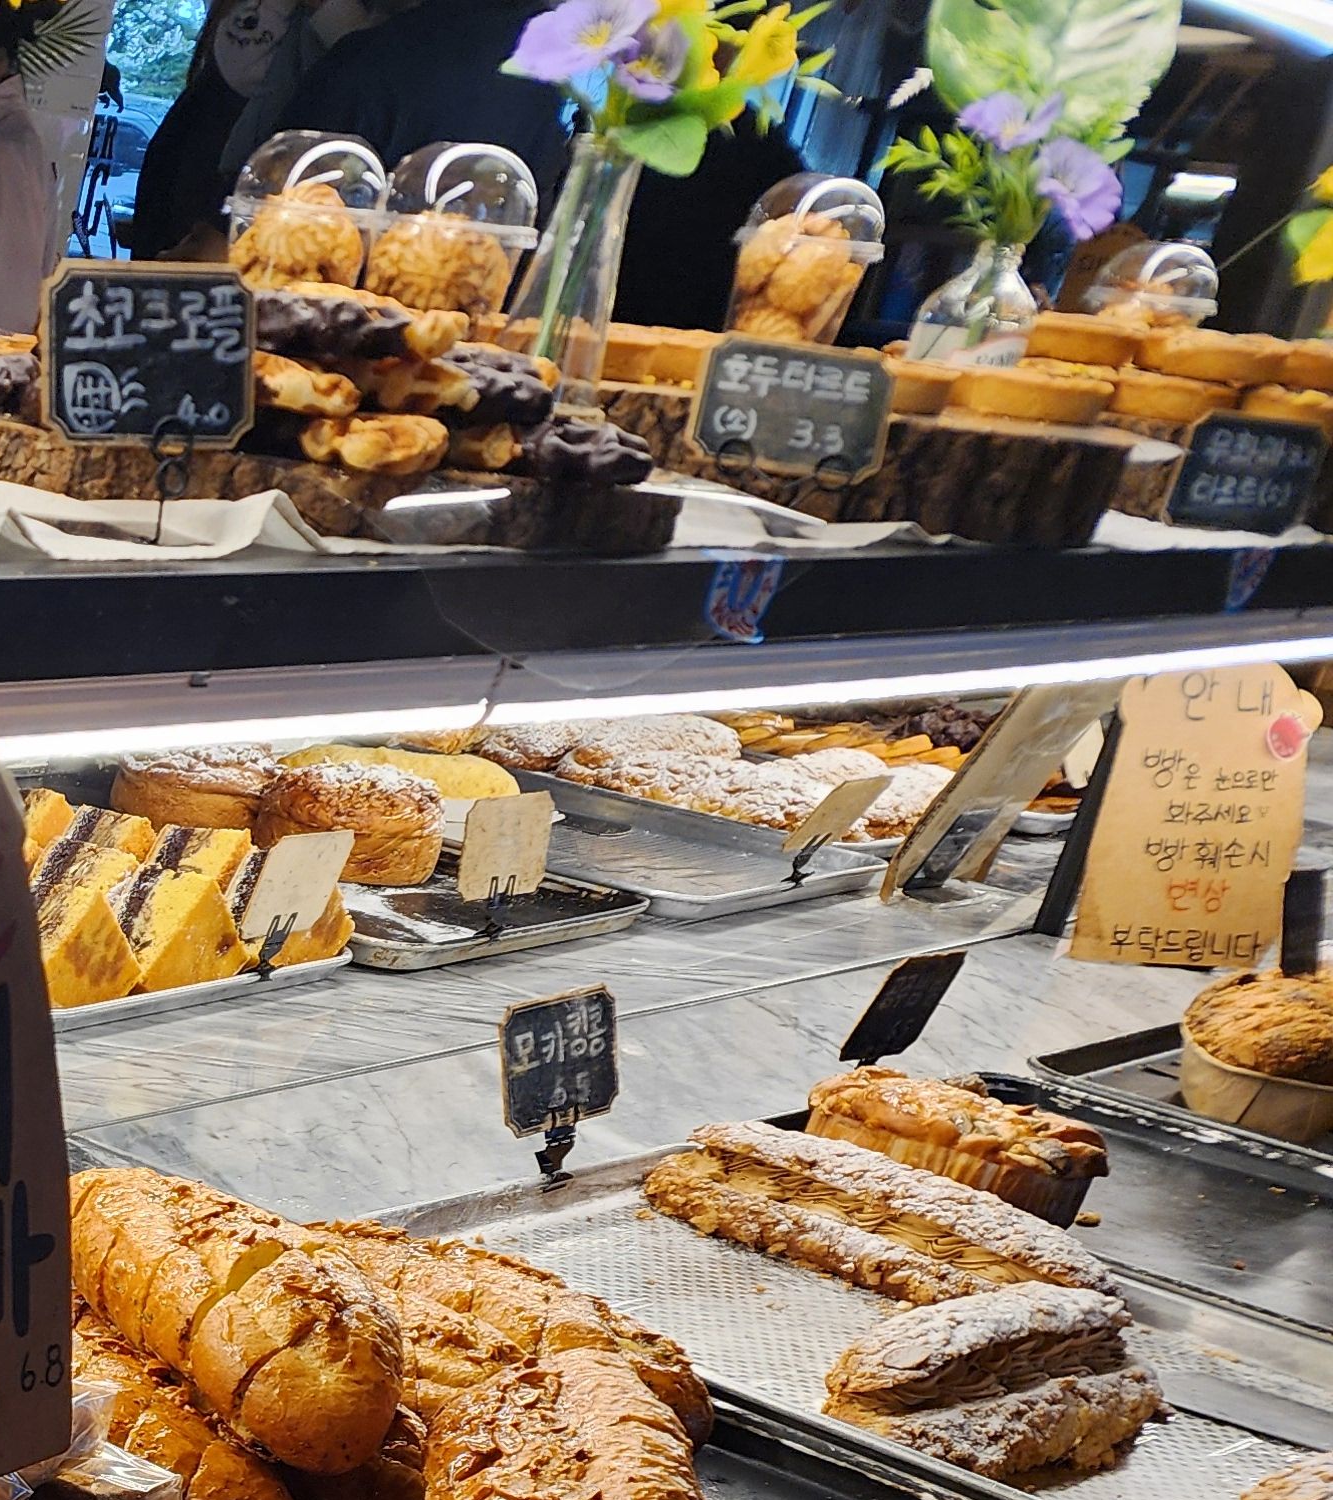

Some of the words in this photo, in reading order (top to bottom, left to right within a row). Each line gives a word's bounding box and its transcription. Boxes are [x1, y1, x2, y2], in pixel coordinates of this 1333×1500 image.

[787, 417, 845, 455] 3.3
[1144, 748, 1201, 790] 빵은
[1215, 767, 1278, 792] 눈으로만
[1164, 800, 1254, 825] 봐주세요
[1146, 837, 1189, 872] 빵
[1167, 877, 1231, 913] 변상
[1109, 922, 1263, 963] 부탁드립니다
[20, 1343, 65, 1393] 6.8
